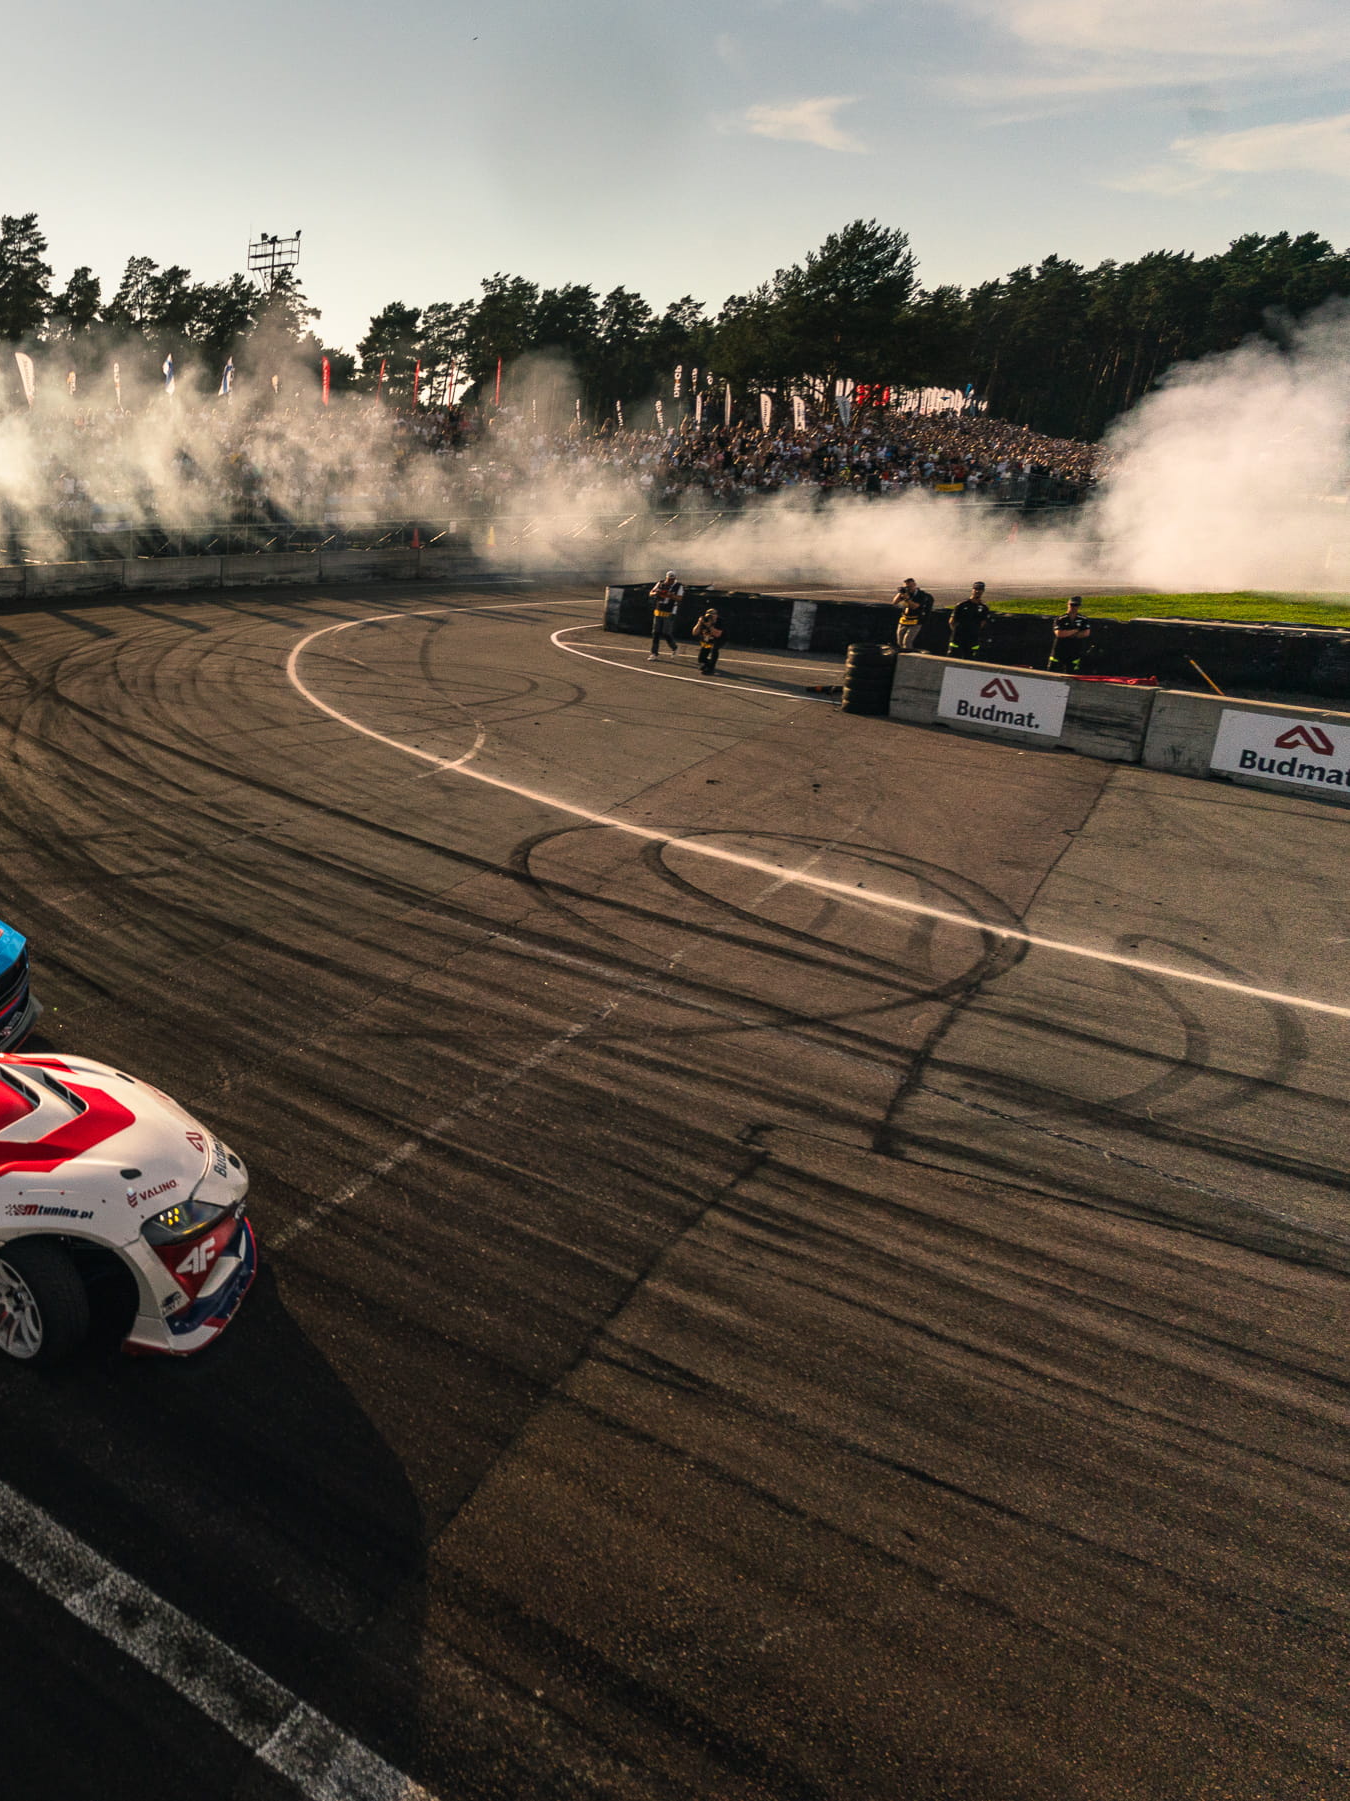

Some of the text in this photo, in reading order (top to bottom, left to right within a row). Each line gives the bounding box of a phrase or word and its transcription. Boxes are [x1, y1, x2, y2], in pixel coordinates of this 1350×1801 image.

[956, 699, 1040, 729] Budmat.
[139, 1179, 178, 1201] VALINO
[175, 1236, 216, 1275] 4F
